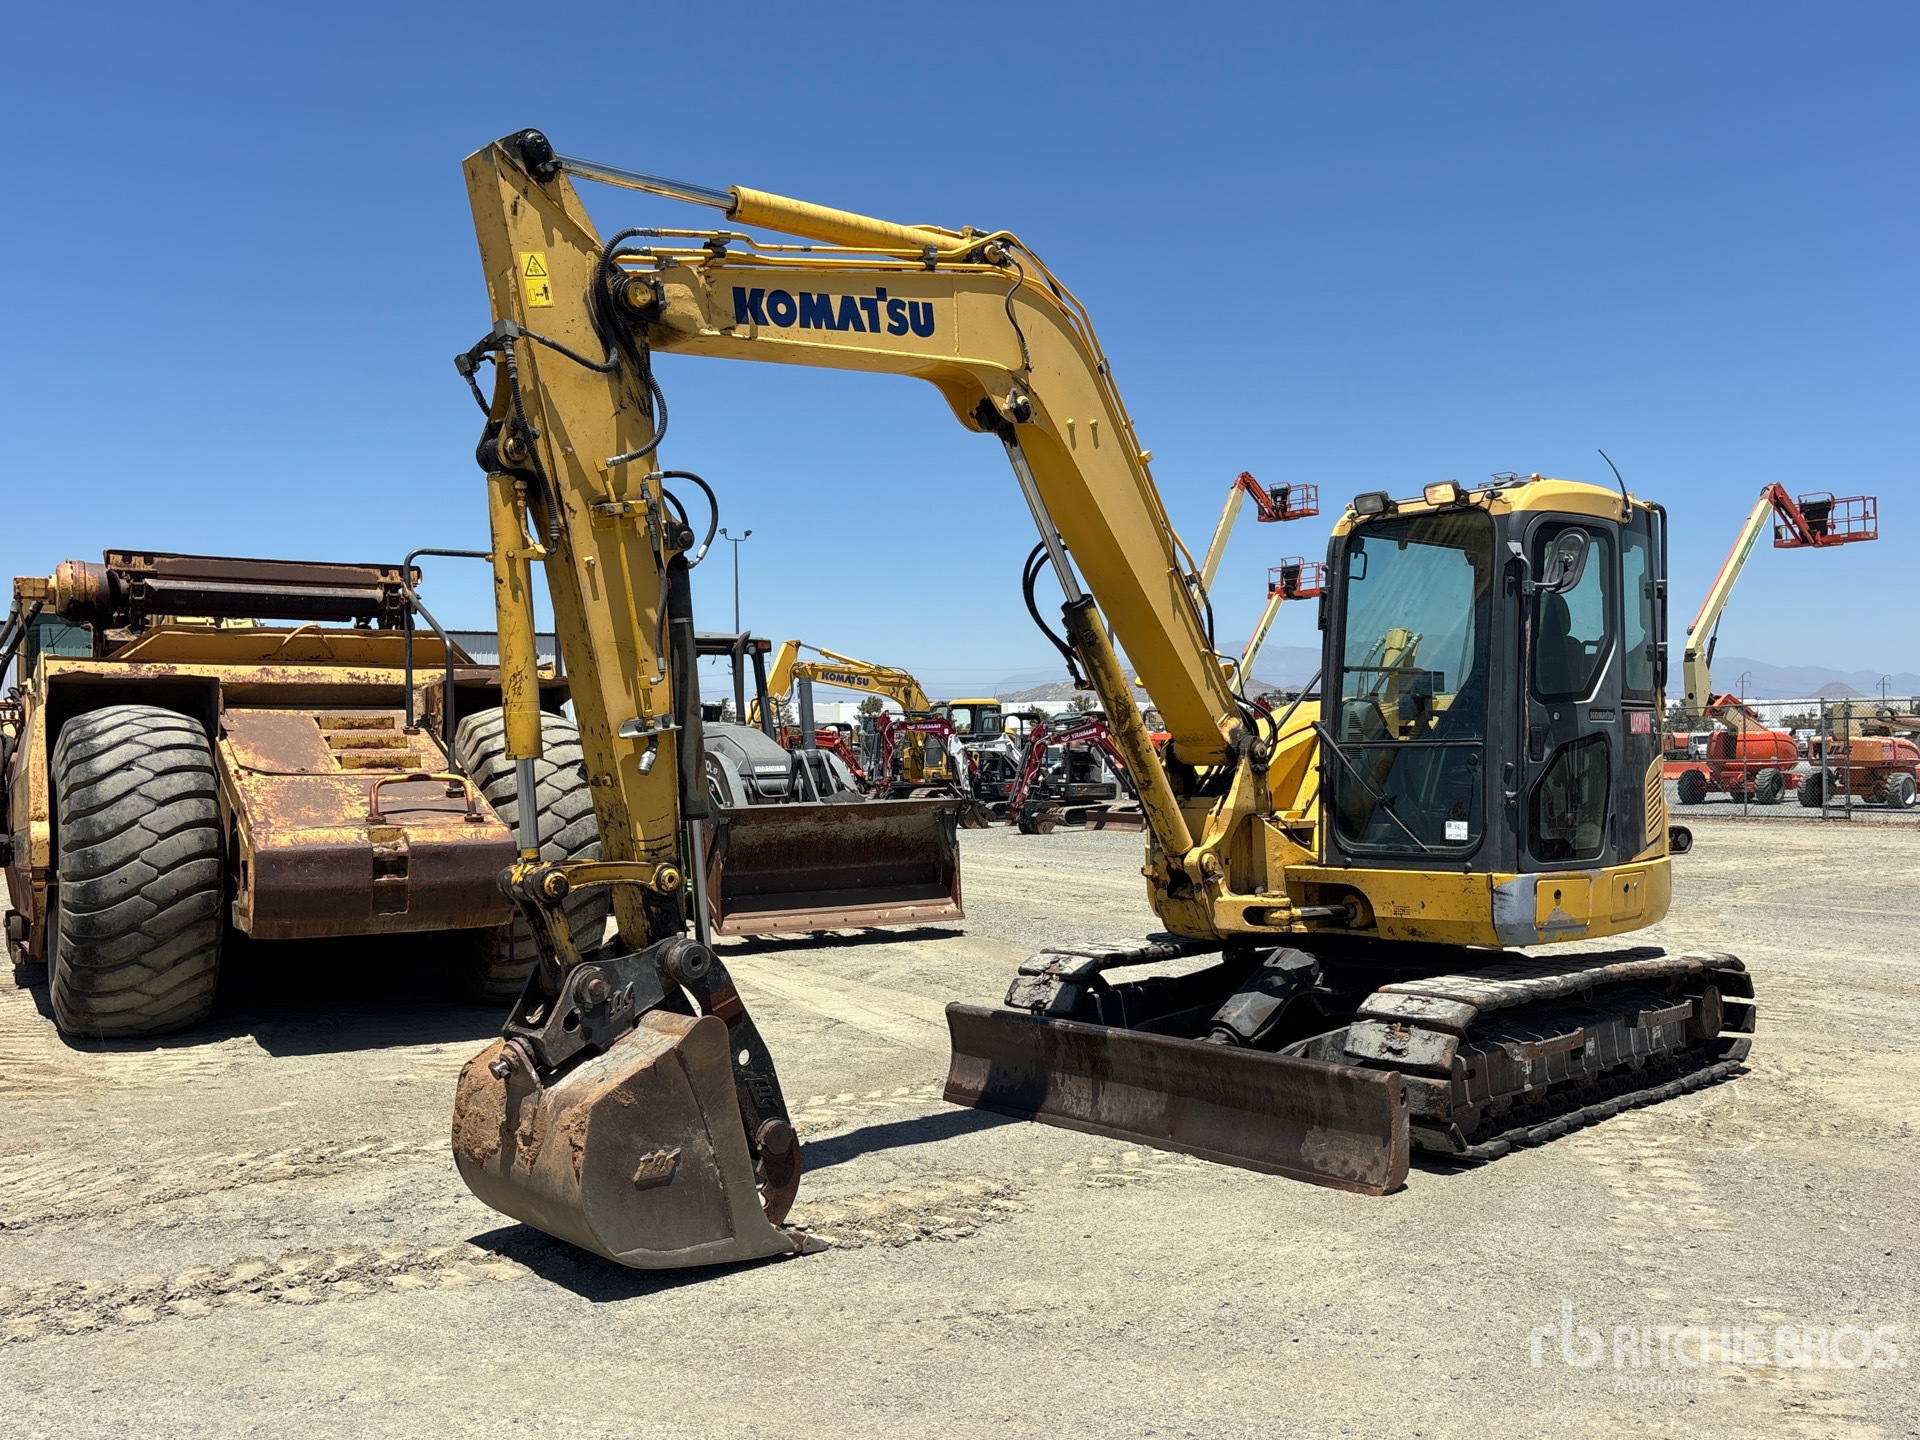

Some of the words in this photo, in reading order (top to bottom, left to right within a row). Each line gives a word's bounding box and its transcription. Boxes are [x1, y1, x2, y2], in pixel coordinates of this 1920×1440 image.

[732, 286, 935, 338] KOMATSU
[821, 671, 869, 686] KOMATSU
[1589, 710, 1615, 720] KOMATSU
[1071, 728, 1097, 739] YANMAR
